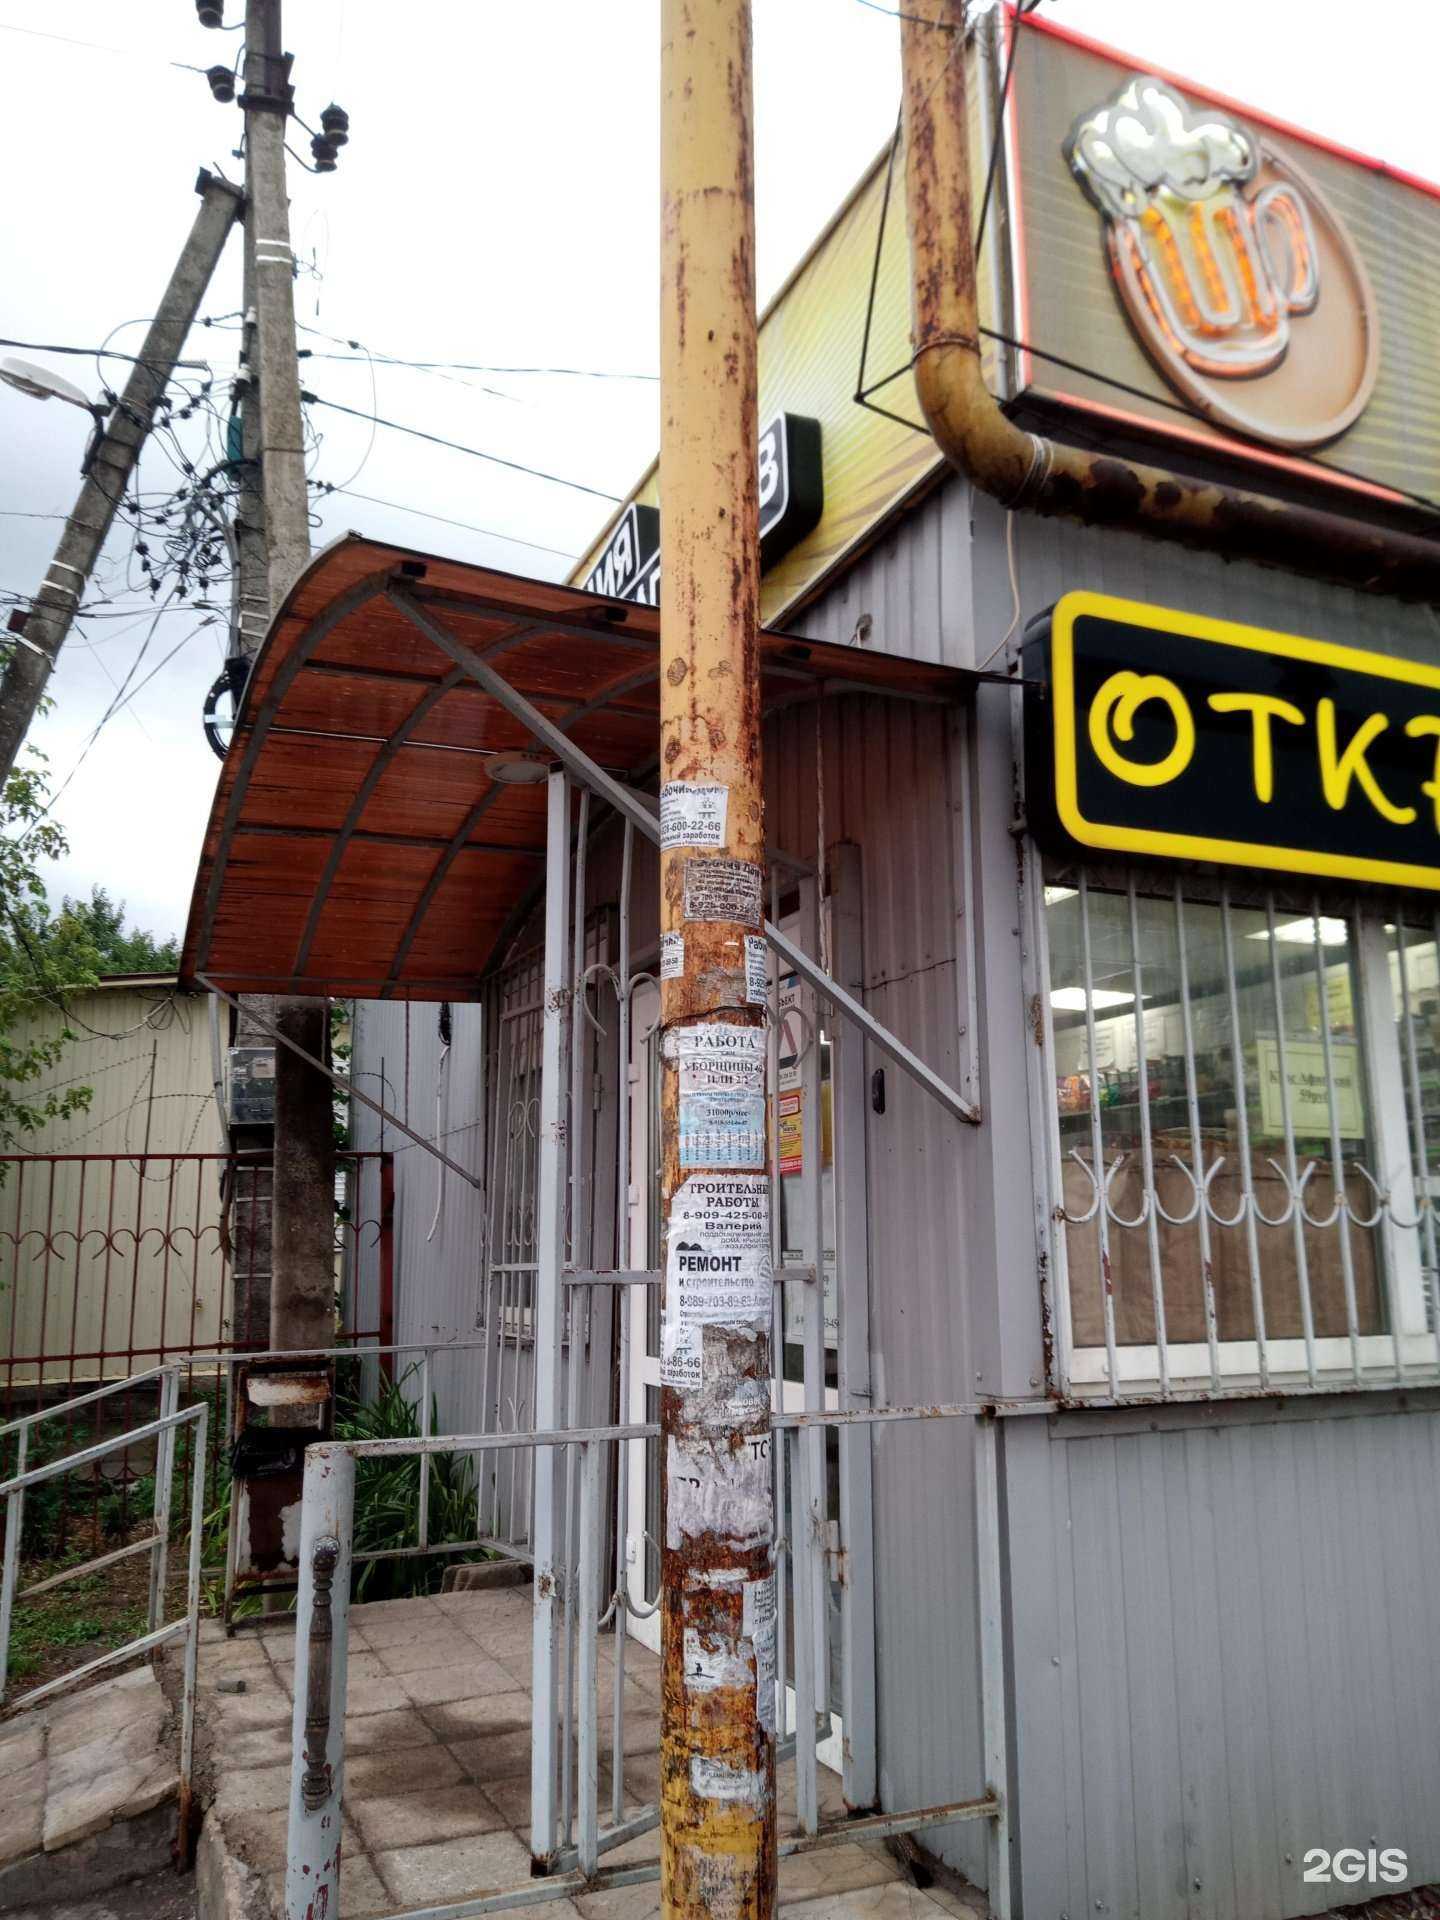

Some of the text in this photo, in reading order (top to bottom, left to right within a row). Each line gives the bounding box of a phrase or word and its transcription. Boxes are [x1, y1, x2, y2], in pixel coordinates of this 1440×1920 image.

[694, 1034, 756, 1050] РАБОТА
[684, 1061, 754, 1074] УБОРЩИЦЫ
[705, 1196, 760, 1208] РАБОТЫ
[704, 1221, 762, 1232] Валерий
[679, 1255, 742, 1272] РЕМОНТ
